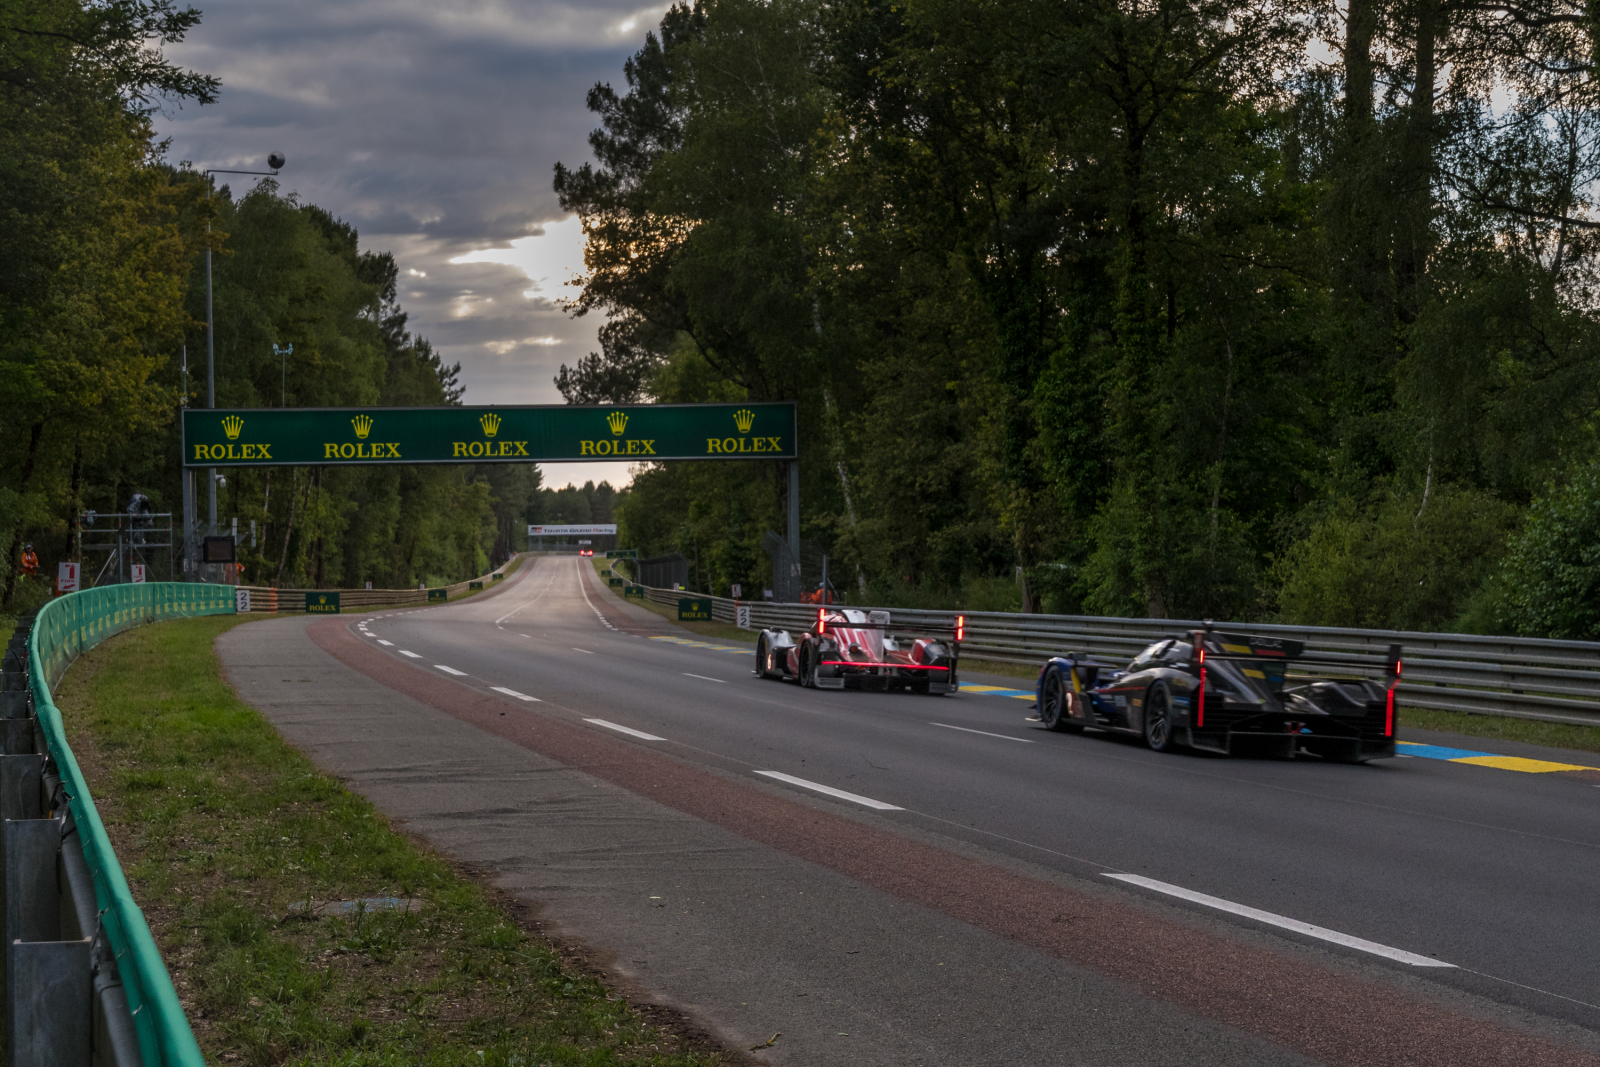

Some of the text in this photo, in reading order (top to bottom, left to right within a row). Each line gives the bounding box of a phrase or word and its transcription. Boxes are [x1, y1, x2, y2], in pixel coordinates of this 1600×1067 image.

[194, 443, 273, 460] ROLEX
[323, 442, 402, 459] ROLEX
[452, 440, 530, 457] ROLEX
[580, 439, 656, 456] ROLEX
[706, 436, 783, 453] ROLEX
[309, 604, 336, 612] ROLEX
